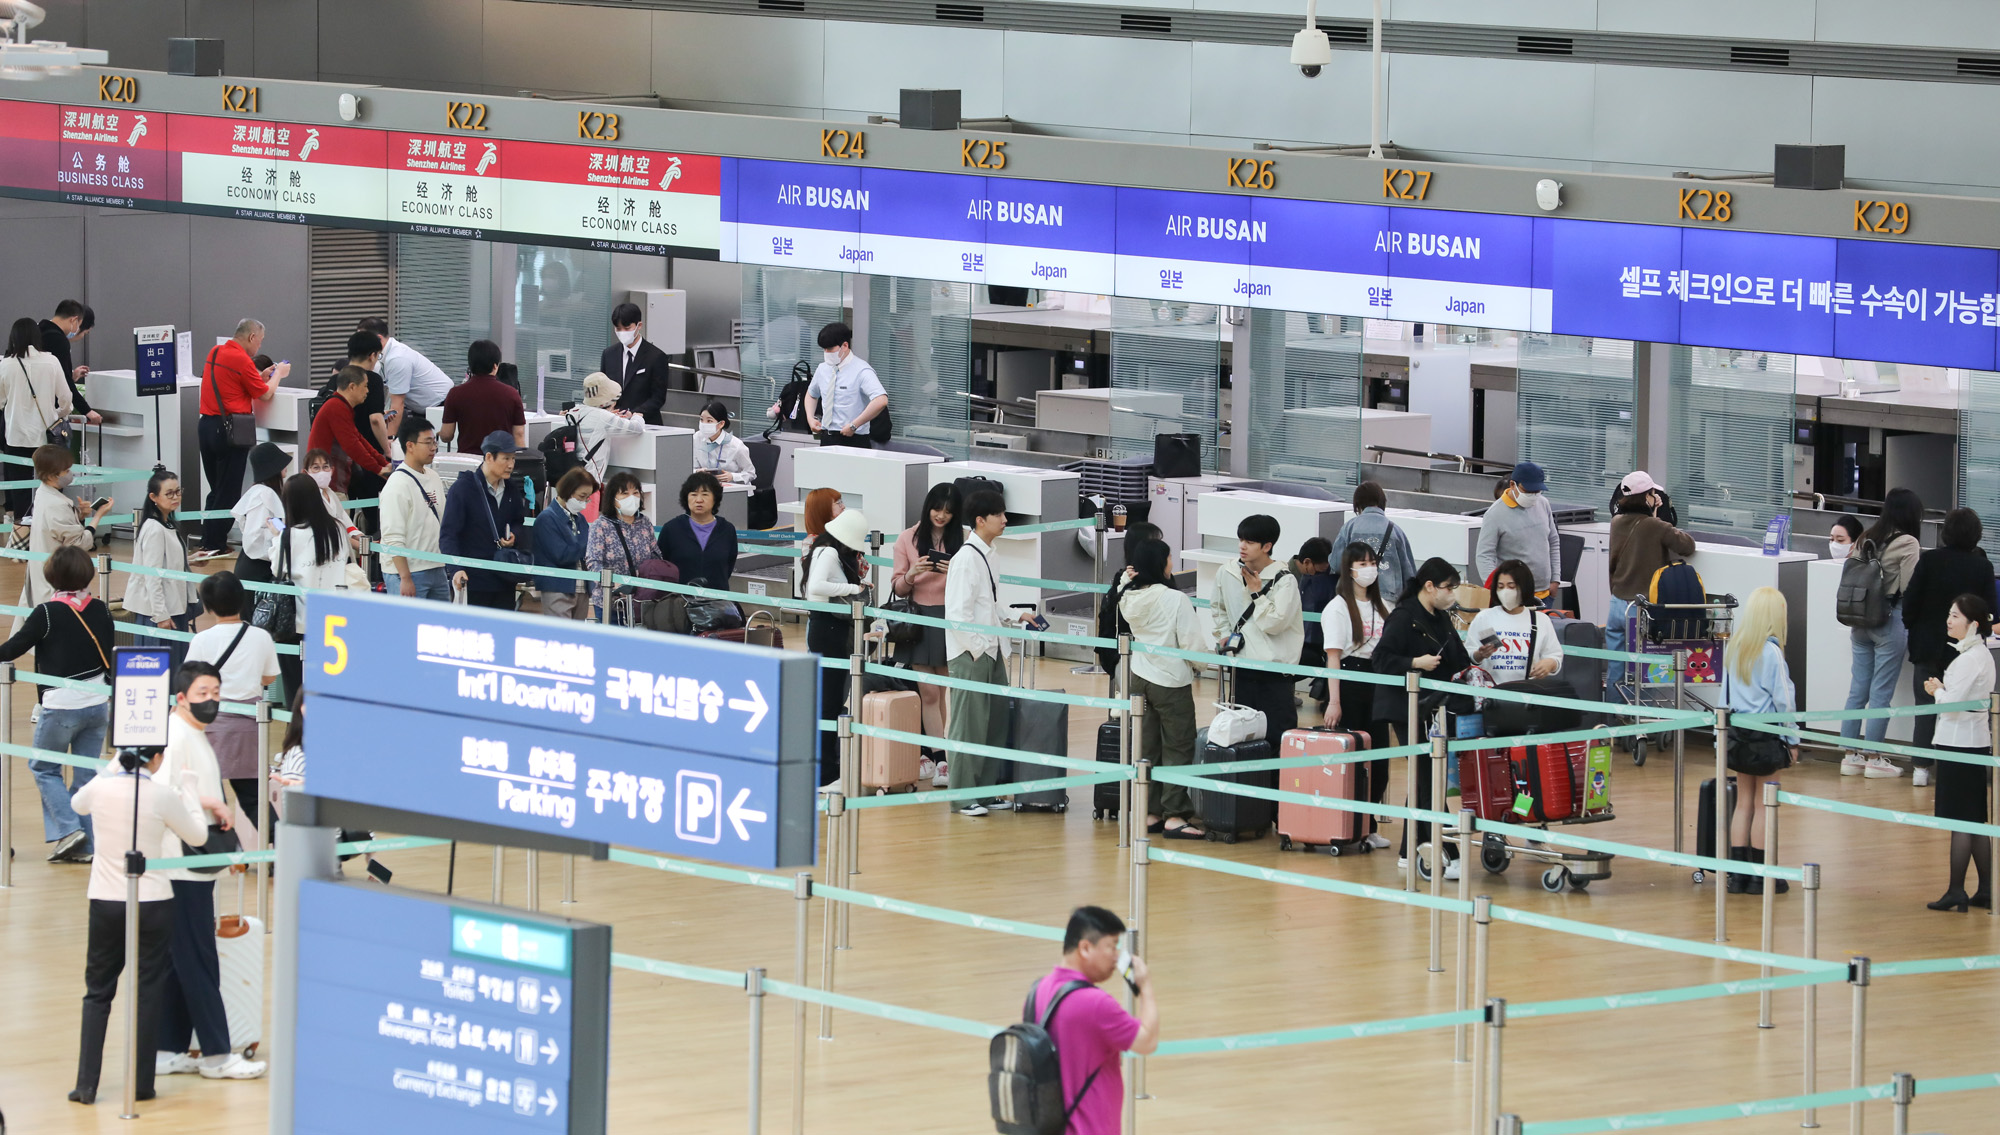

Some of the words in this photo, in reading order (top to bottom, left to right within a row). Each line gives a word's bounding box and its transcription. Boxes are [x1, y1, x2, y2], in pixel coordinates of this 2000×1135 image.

[99, 75, 137, 103] K20
[222, 84, 260, 113] K21
[64, 111, 118, 132] 深圳航空
[446, 102, 488, 131] K22
[578, 112, 619, 141] K23
[63, 130, 93, 142] Shenzhen
[94, 132, 118, 144] Airlines
[233, 125, 290, 146] 深圳航空
[821, 129, 865, 159] K24
[232, 144, 262, 156] Shenzhen
[264, 147, 290, 158] Airlines
[408, 139, 466, 160] 深圳航空
[961, 138, 1006, 170] K25
[72, 152, 130, 173] 公务舱
[406, 158, 438, 170] Shenzhen
[440, 160, 466, 172] Airlines
[588, 153, 650, 174] 深圳航空
[58, 170, 108, 187] BUSINESS
[111, 174, 144, 190] CLASS
[241, 166, 301, 188] 经济舱
[587, 173, 620, 184] Shenzhen
[622, 175, 649, 186] Airlines
[1227, 158, 1275, 190] K26
[1382, 168, 1432, 200] K27
[84, 196, 104, 204] ALLIANCE
[106, 198, 125, 206] MEMBER
[227, 186, 278, 202] ECONOMY
[282, 189, 316, 204] CLASS
[416, 182, 478, 203] 经济舱
[778, 184, 802, 206] AIR
[806, 186, 869, 211] BUSAN
[402, 201, 455, 218] ECONOMY
[458, 204, 493, 220] CLASS
[598, 196, 662, 218] 经济舱
[967, 199, 992, 222] AIR
[998, 201, 1063, 226] BUSAN
[1678, 188, 1732, 222] K28
[254, 212, 276, 220] ALLIANCE
[277, 214, 296, 222] MEMBER
[582, 216, 637, 232] ECONOMY
[641, 220, 677, 236] CLASS
[1854, 200, 1909, 234] K29
[430, 227, 450, 235] ALLIANCE
[1166, 214, 1192, 238] AIR
[1198, 217, 1267, 243] BUSAN
[610, 243, 632, 251] ALLIANCE
[772, 236, 794, 256] 일본
[839, 245, 874, 264] Japan
[1374, 230, 1402, 254] AIR
[1408, 232, 1480, 260] BUSAN
[961, 252, 984, 272] 일본
[1032, 262, 1067, 280] Japan
[1160, 270, 1184, 289] 일본
[1234, 278, 1271, 299] Japan
[1368, 286, 1393, 307] 일본
[1620, 266, 1662, 298] 셀프
[1668, 270, 1775, 306] 체크인으로
[1782, 278, 1802, 311] 더
[1809, 280, 1854, 314] 빠른
[1860, 284, 1927, 321] 수속이
[1446, 296, 1485, 316] Japan
[147, 348, 164, 356] 出口
[324, 614, 348, 676] 5
[458, 669, 497, 701] Int'l
[502, 674, 595, 724] Boarding
[124, 724, 156, 734] Entrance
[498, 779, 576, 828] Parking
[586, 769, 665, 823] 주차장
